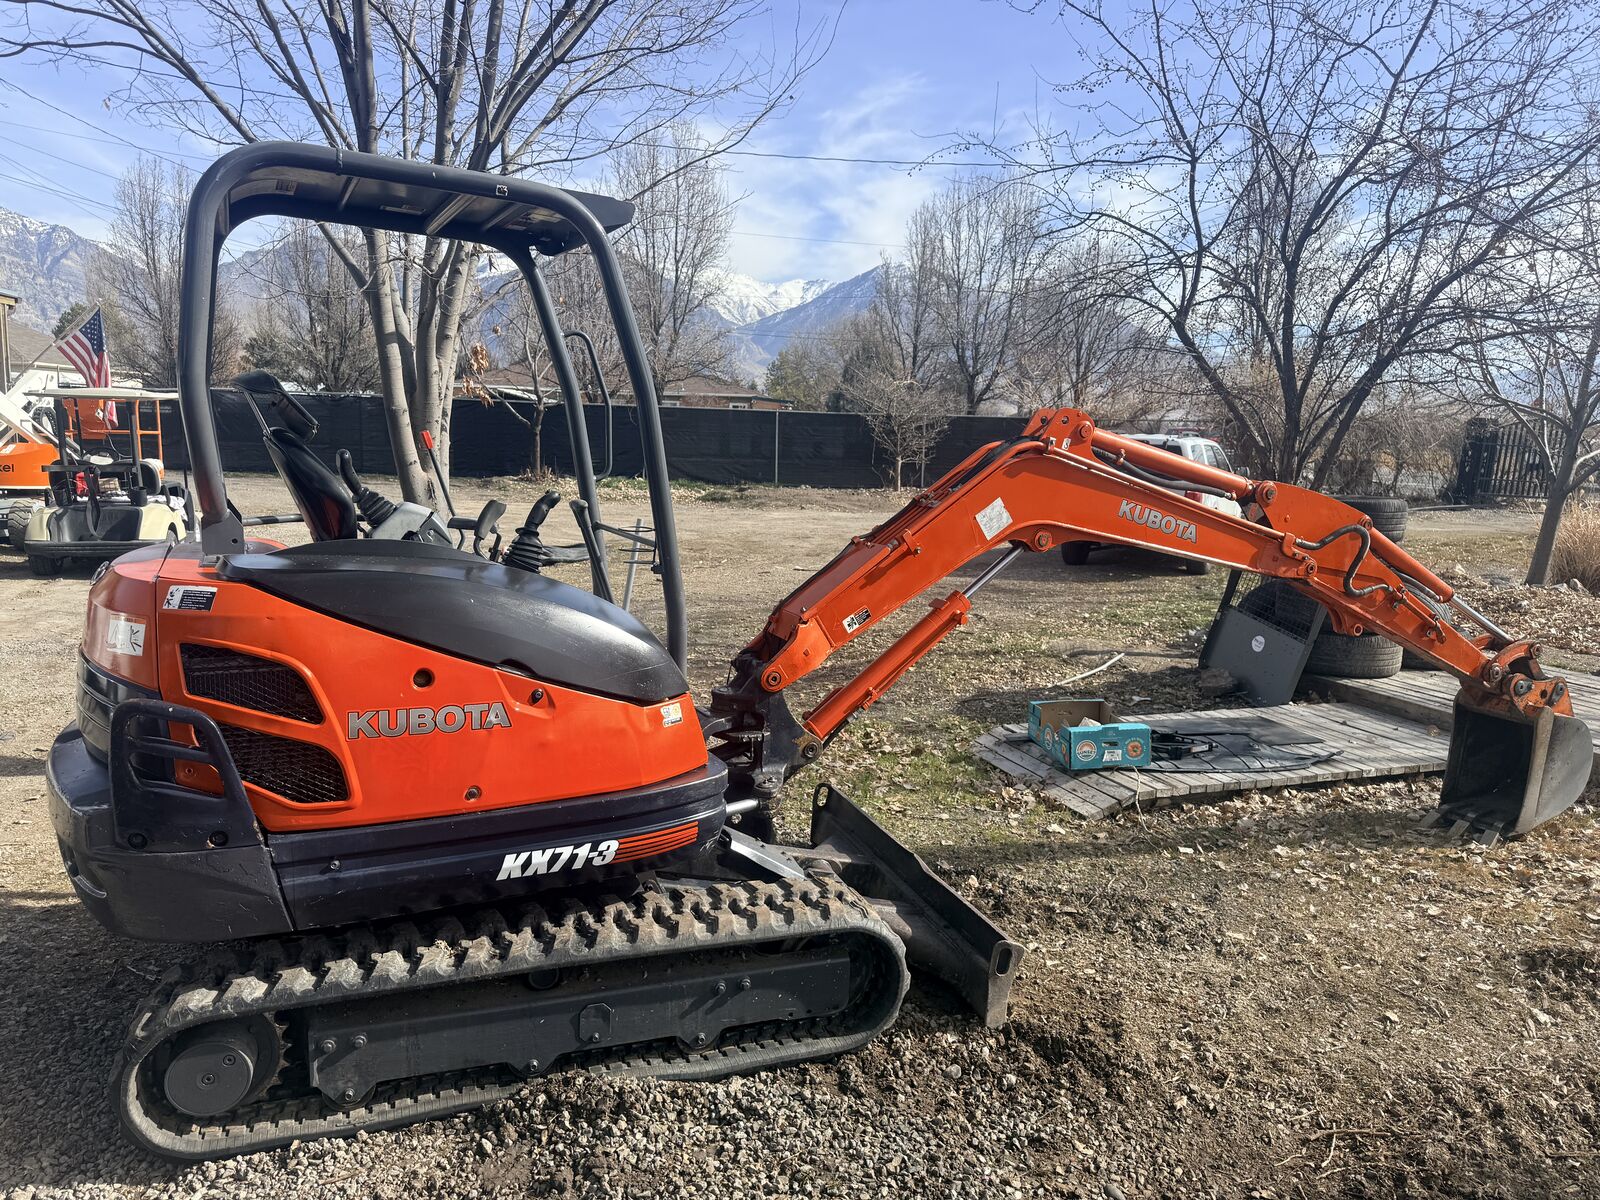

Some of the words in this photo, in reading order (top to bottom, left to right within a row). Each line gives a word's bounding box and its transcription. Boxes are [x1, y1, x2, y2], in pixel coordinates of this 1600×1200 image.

[1118, 499, 1198, 544] KUBOTA
[347, 702, 512, 740] KUBOTA
[496, 839, 620, 881] KX71-3
